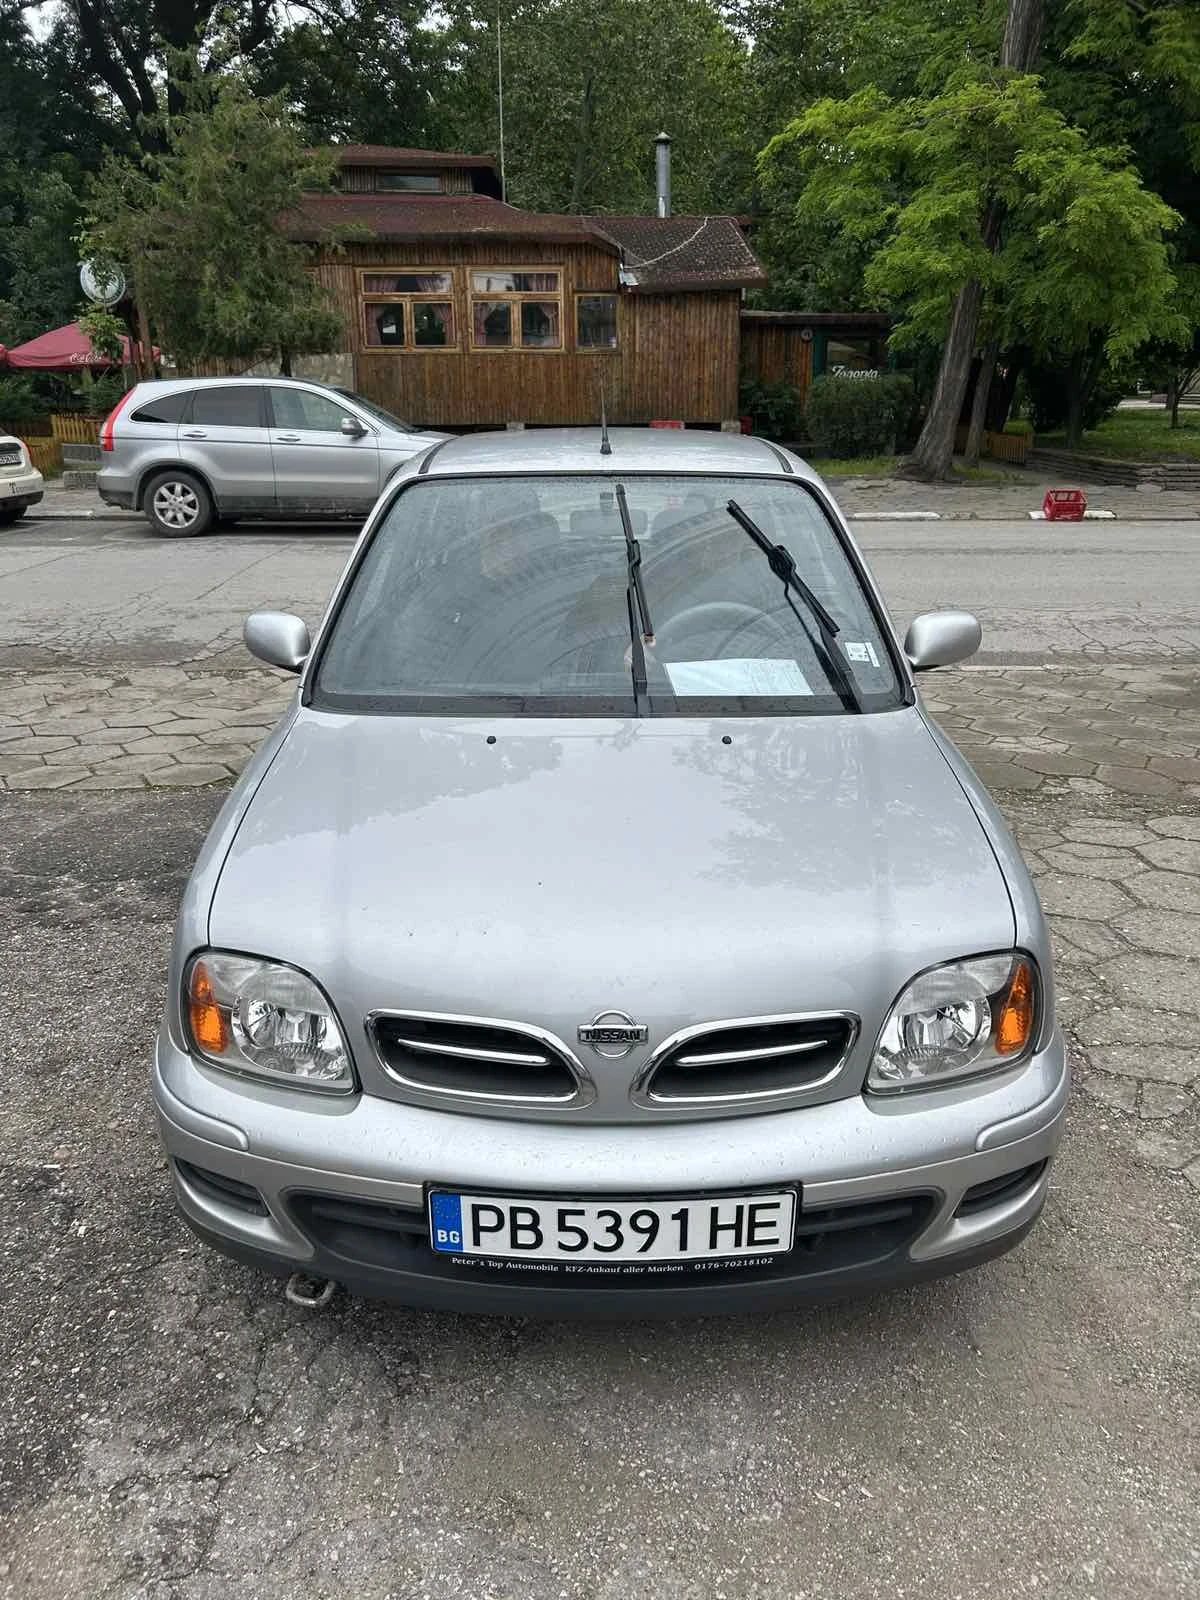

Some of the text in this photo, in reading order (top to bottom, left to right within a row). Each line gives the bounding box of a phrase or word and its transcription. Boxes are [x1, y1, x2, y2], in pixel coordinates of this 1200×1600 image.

[580, 1028, 645, 1042] NISSAN
[471, 1202, 781, 1253] PB 5391 HE
[437, 1229, 460, 1244] BG
[487, 1260, 504, 1269] Top
[506, 1262, 559, 1272] Automobile
[565, 1265, 620, 1273] KFZ-Ankauf
[623, 1265, 645, 1273] aller
